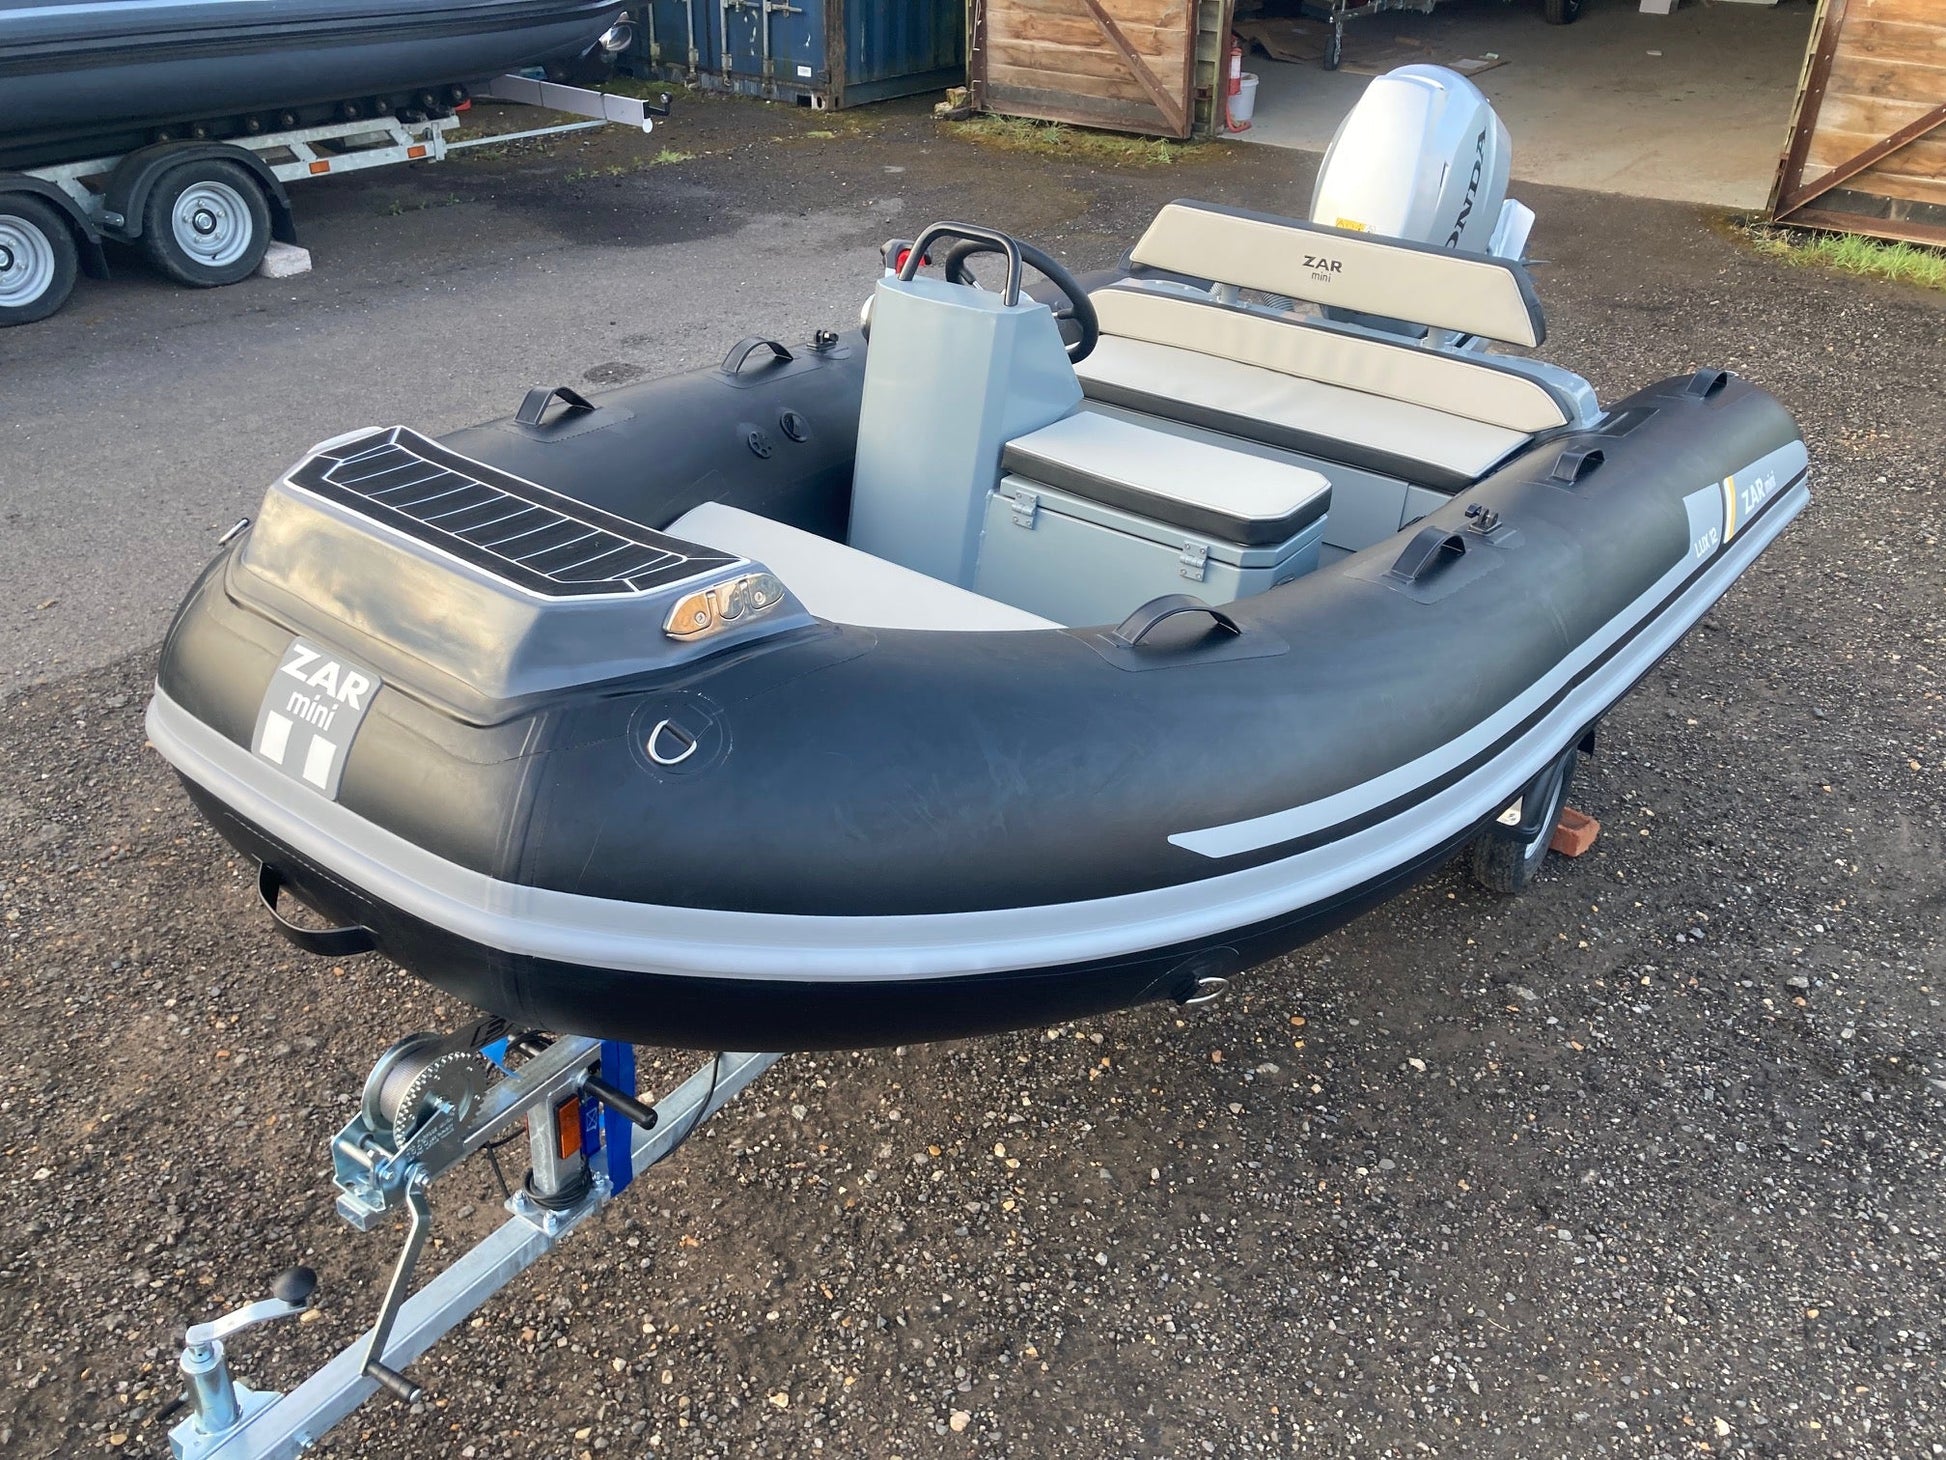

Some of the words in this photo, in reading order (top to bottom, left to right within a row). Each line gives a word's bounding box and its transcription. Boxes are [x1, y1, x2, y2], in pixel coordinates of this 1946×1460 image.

[1445, 126, 1487, 249] ONDA
[1302, 255, 1343, 273] ZAR
[1311, 271, 1332, 283] mini
[1741, 477, 1766, 515] ZAR
[1693, 532, 1711, 559] LUX
[1709, 527, 1719, 545] 12
[280, 643, 370, 711] ZAR
[286, 691, 338, 732] mini
